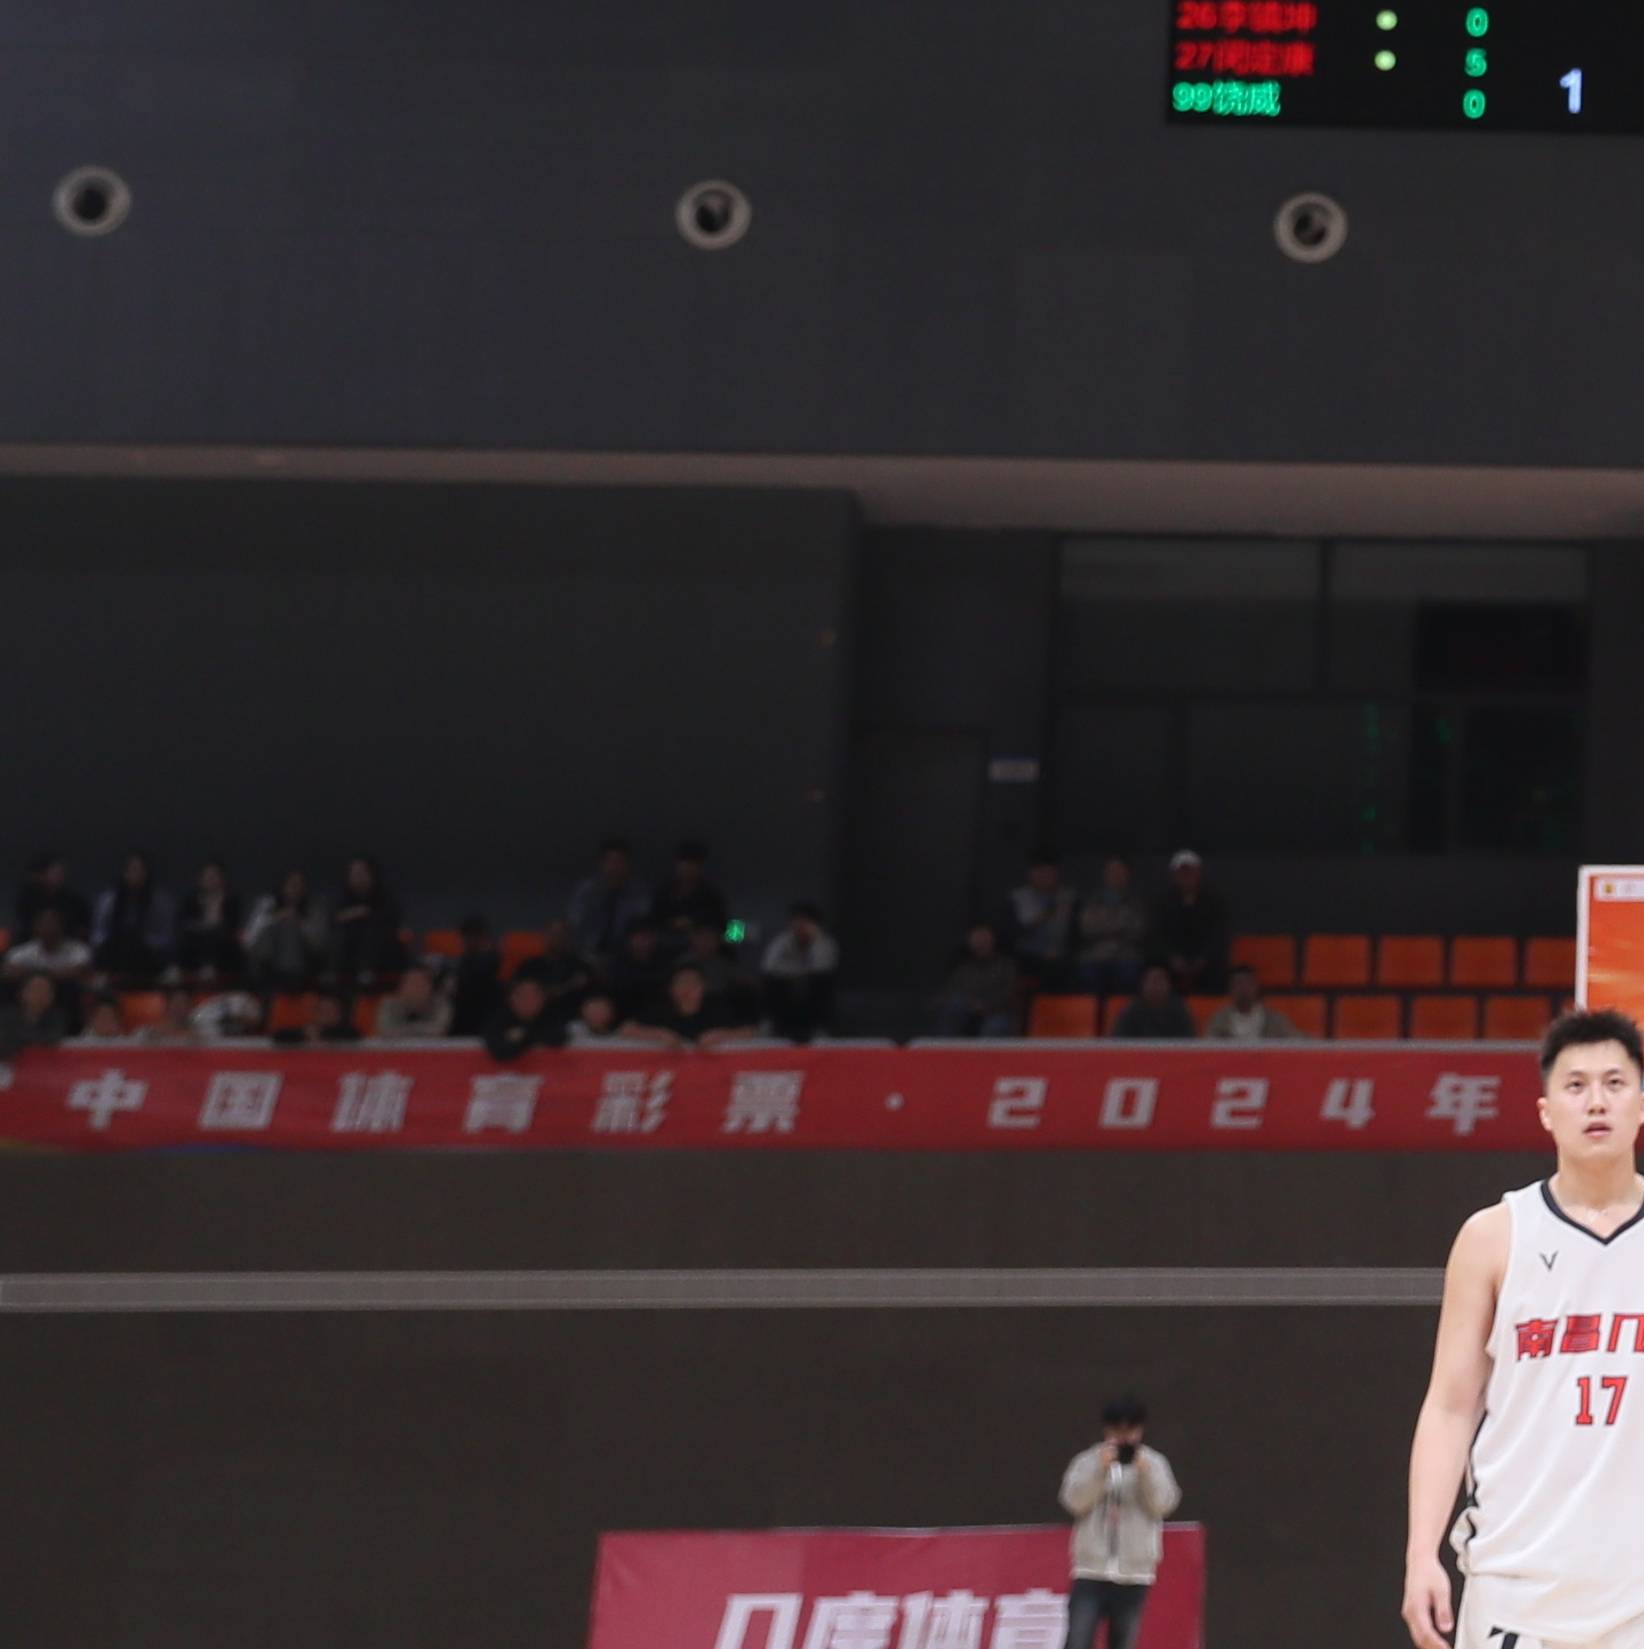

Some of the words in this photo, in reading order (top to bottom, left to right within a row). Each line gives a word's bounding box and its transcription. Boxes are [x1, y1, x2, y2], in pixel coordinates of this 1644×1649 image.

[1465, 8, 1489, 37] 0
[1465, 48, 1487, 77] 5
[1463, 89, 1486, 119] 0
[1560, 68, 1582, 113] 1
[1574, 1375, 1629, 1426] 17
